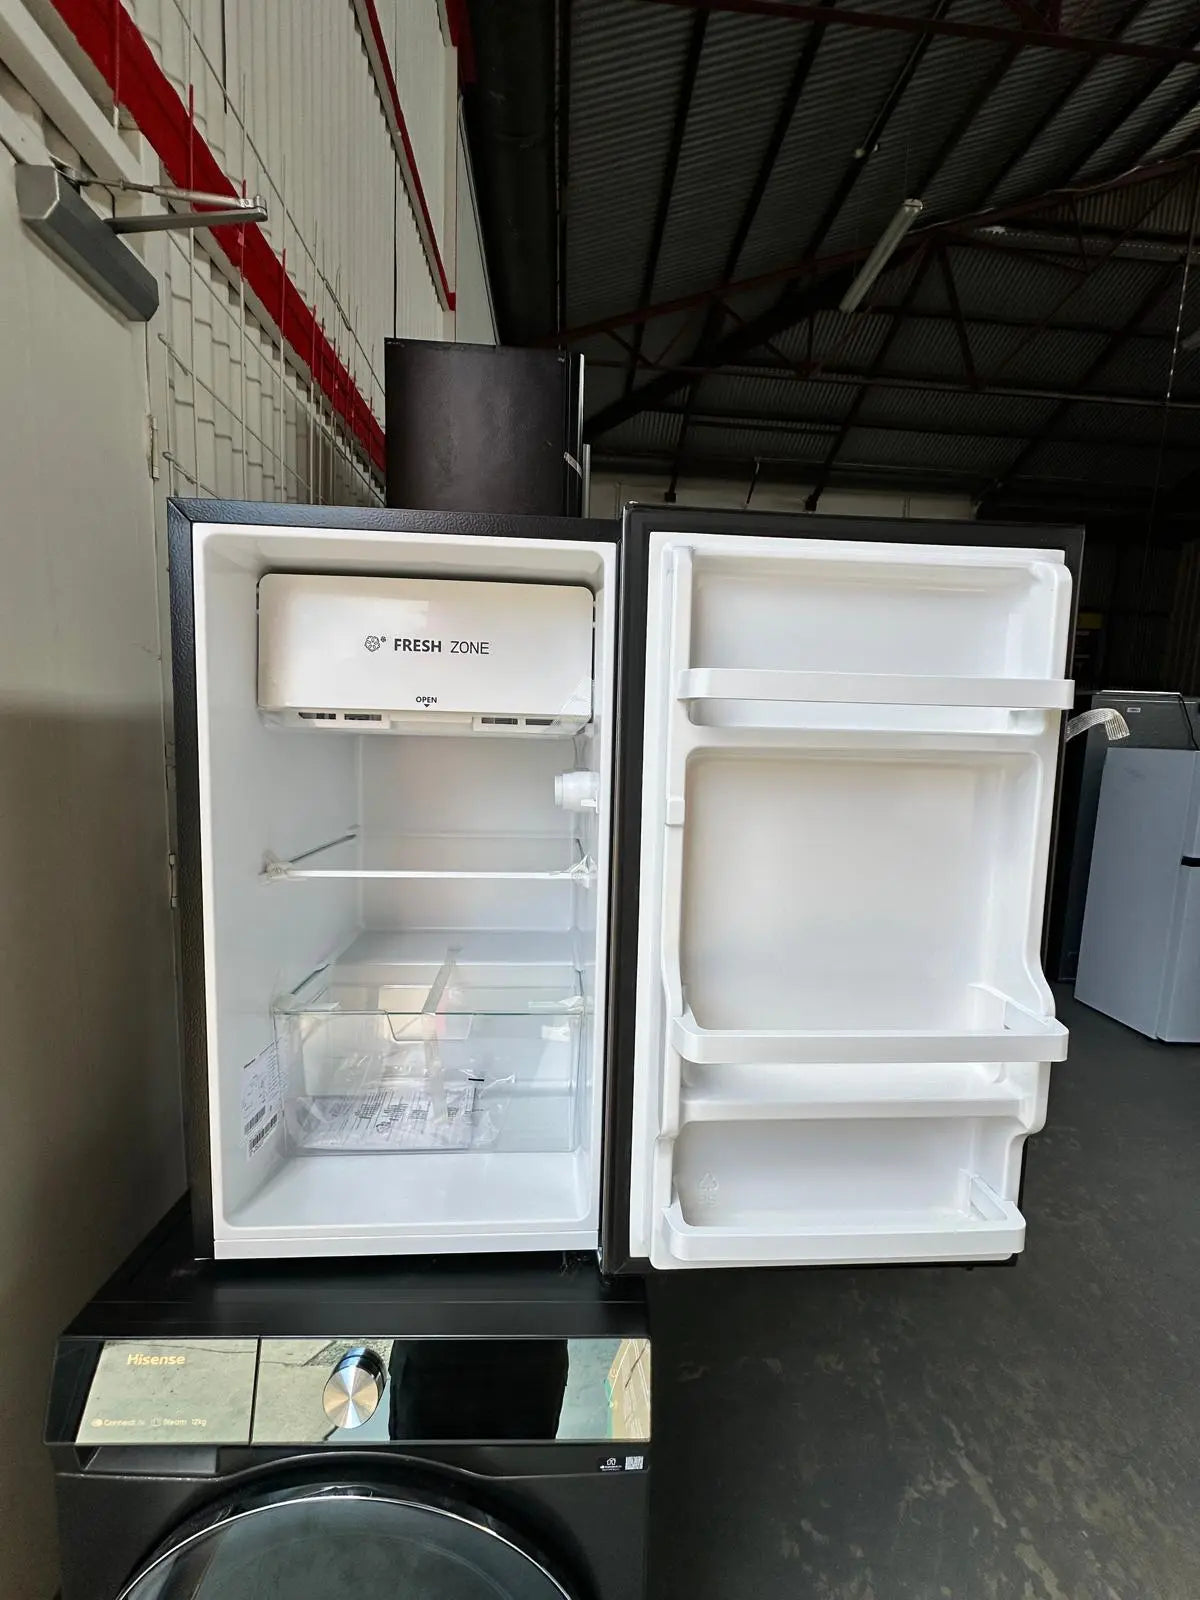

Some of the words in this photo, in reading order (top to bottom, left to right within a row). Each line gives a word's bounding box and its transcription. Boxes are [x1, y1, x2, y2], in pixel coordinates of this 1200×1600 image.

[394, 638, 442, 653] FRESH
[450, 640, 489, 655] ZONE
[415, 696, 438, 704] OPEN
[127, 1353, 186, 1366] Hisense
